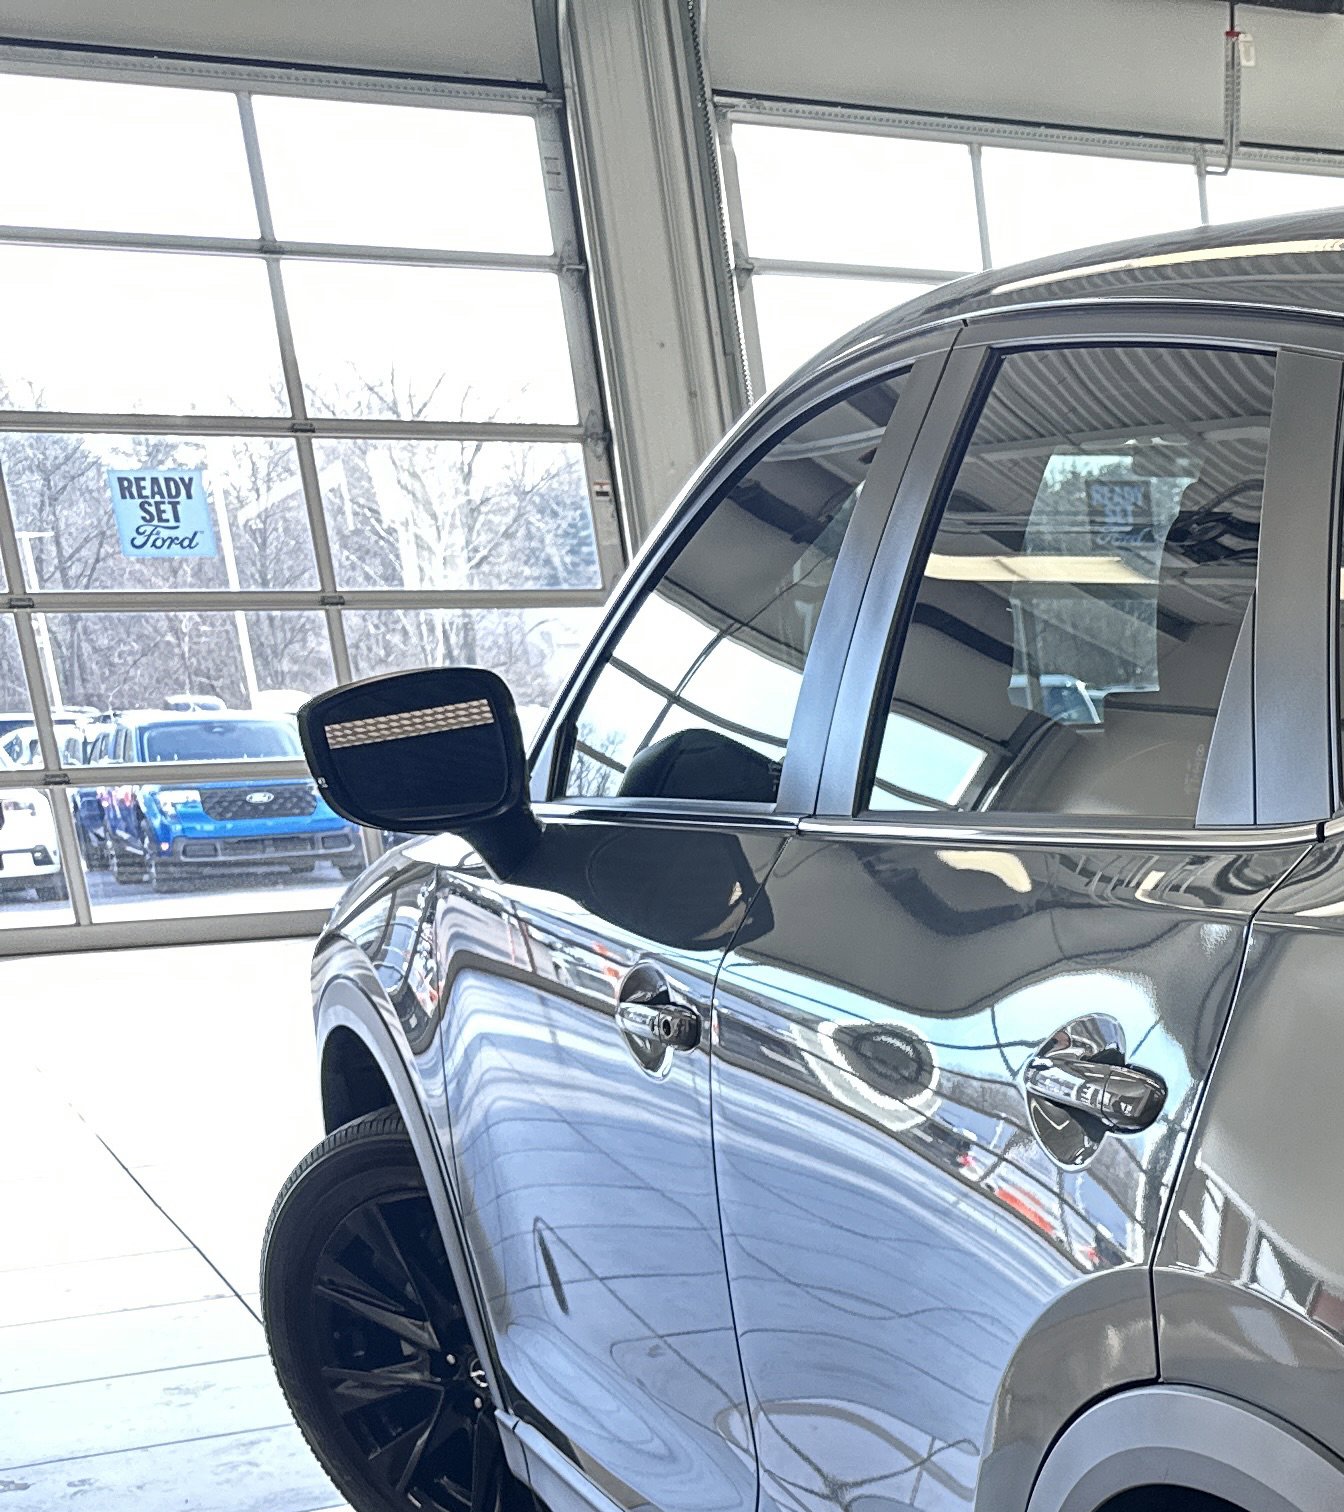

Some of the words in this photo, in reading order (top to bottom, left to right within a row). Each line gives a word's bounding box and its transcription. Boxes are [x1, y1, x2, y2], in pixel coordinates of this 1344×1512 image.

[117, 476, 193, 500] READY
[138, 500, 180, 523] SET
[130, 524, 199, 550] Ford
